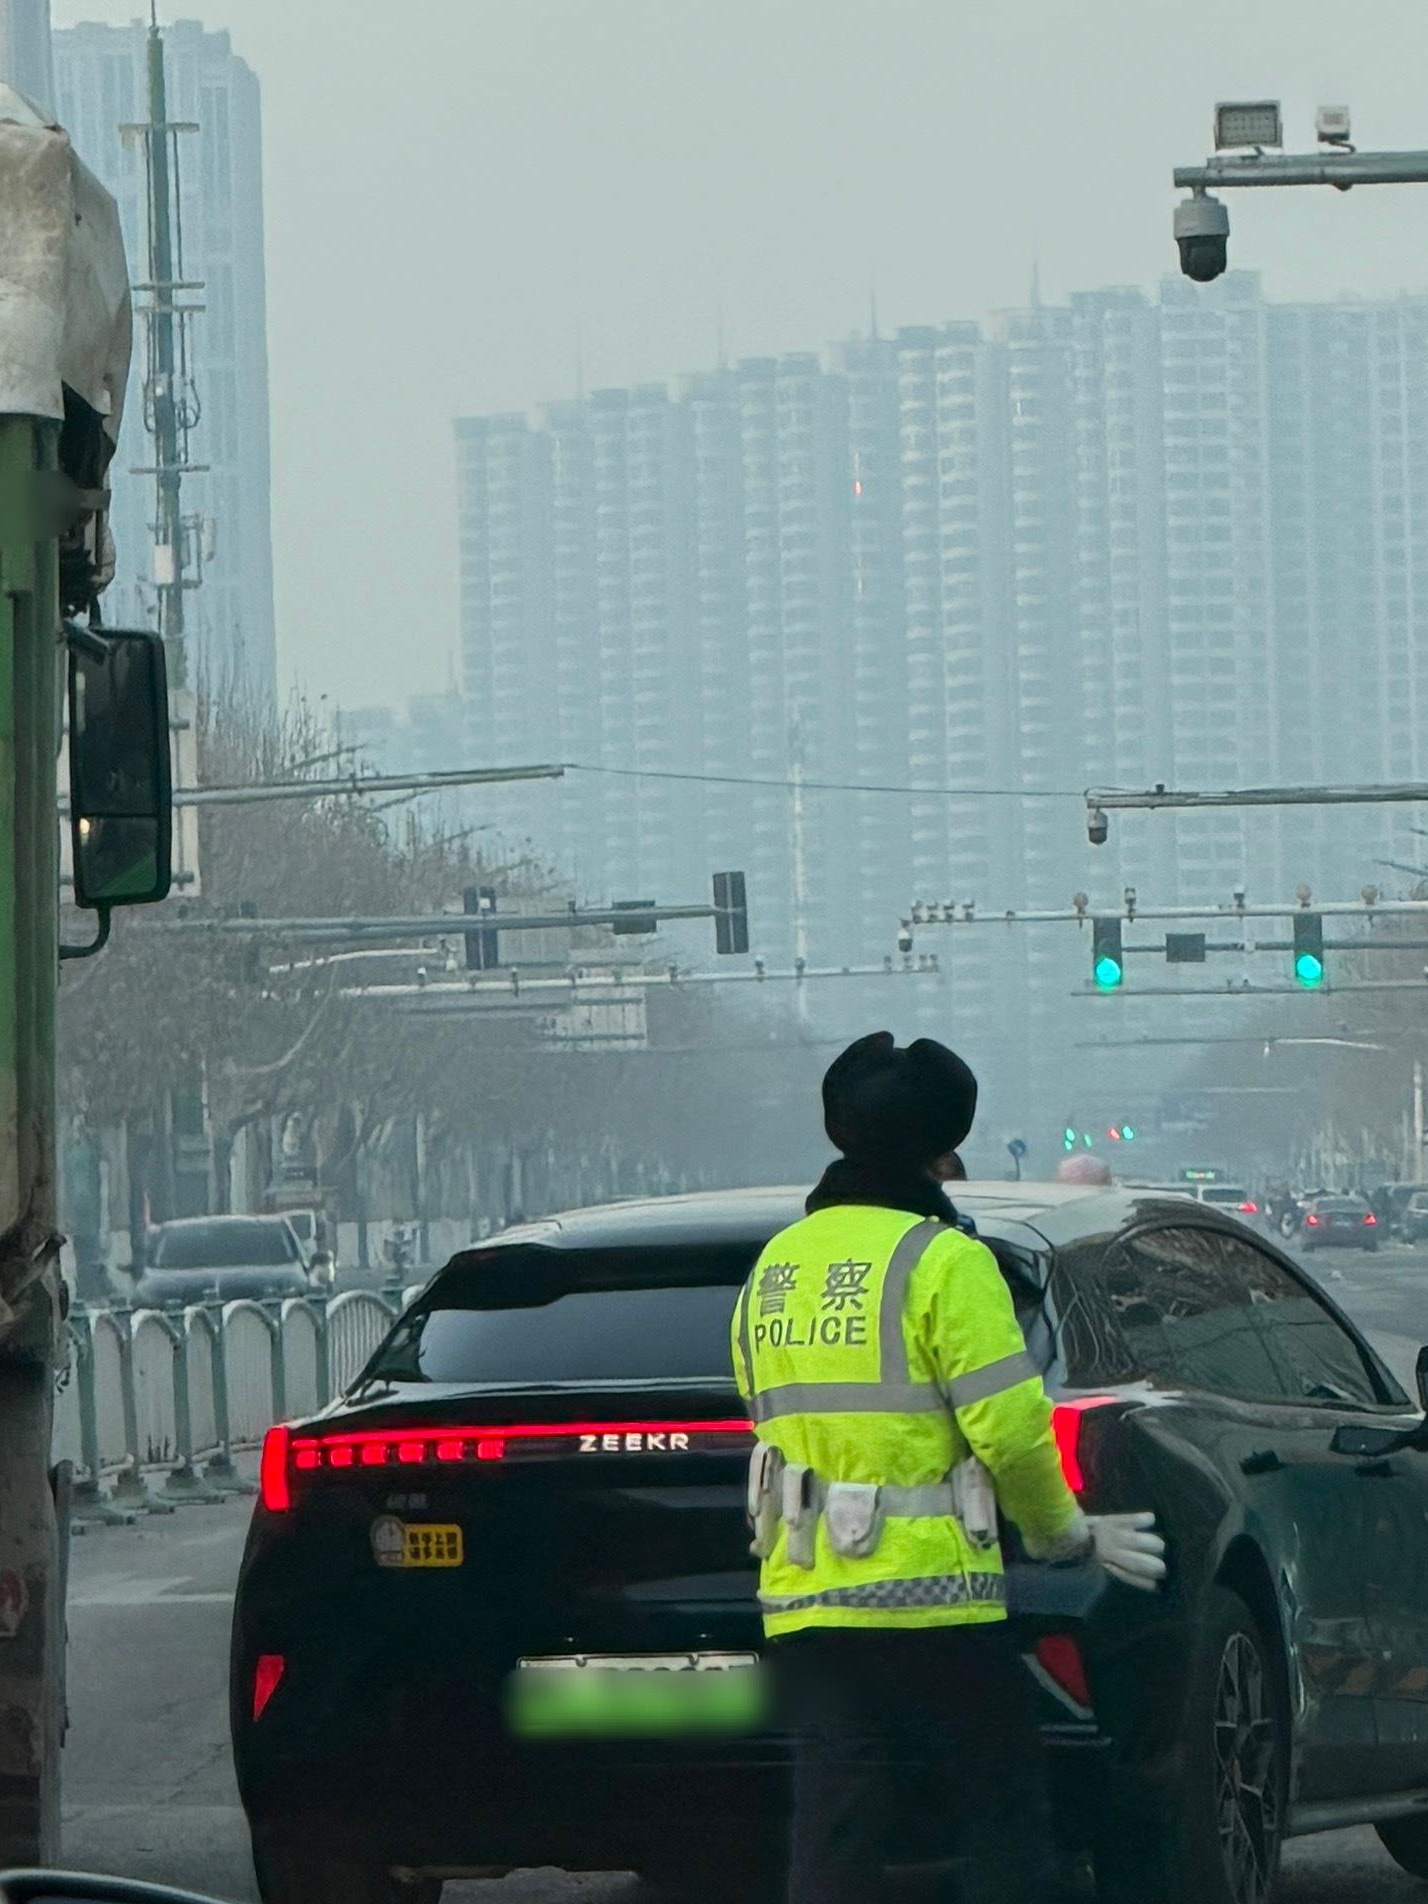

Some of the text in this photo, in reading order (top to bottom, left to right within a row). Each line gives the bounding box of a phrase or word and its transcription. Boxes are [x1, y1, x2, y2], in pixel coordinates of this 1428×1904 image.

[757, 1258, 871, 1316] 警察
[754, 1316, 867, 1353] POLICE
[579, 1432, 690, 1452] ZEEKR
